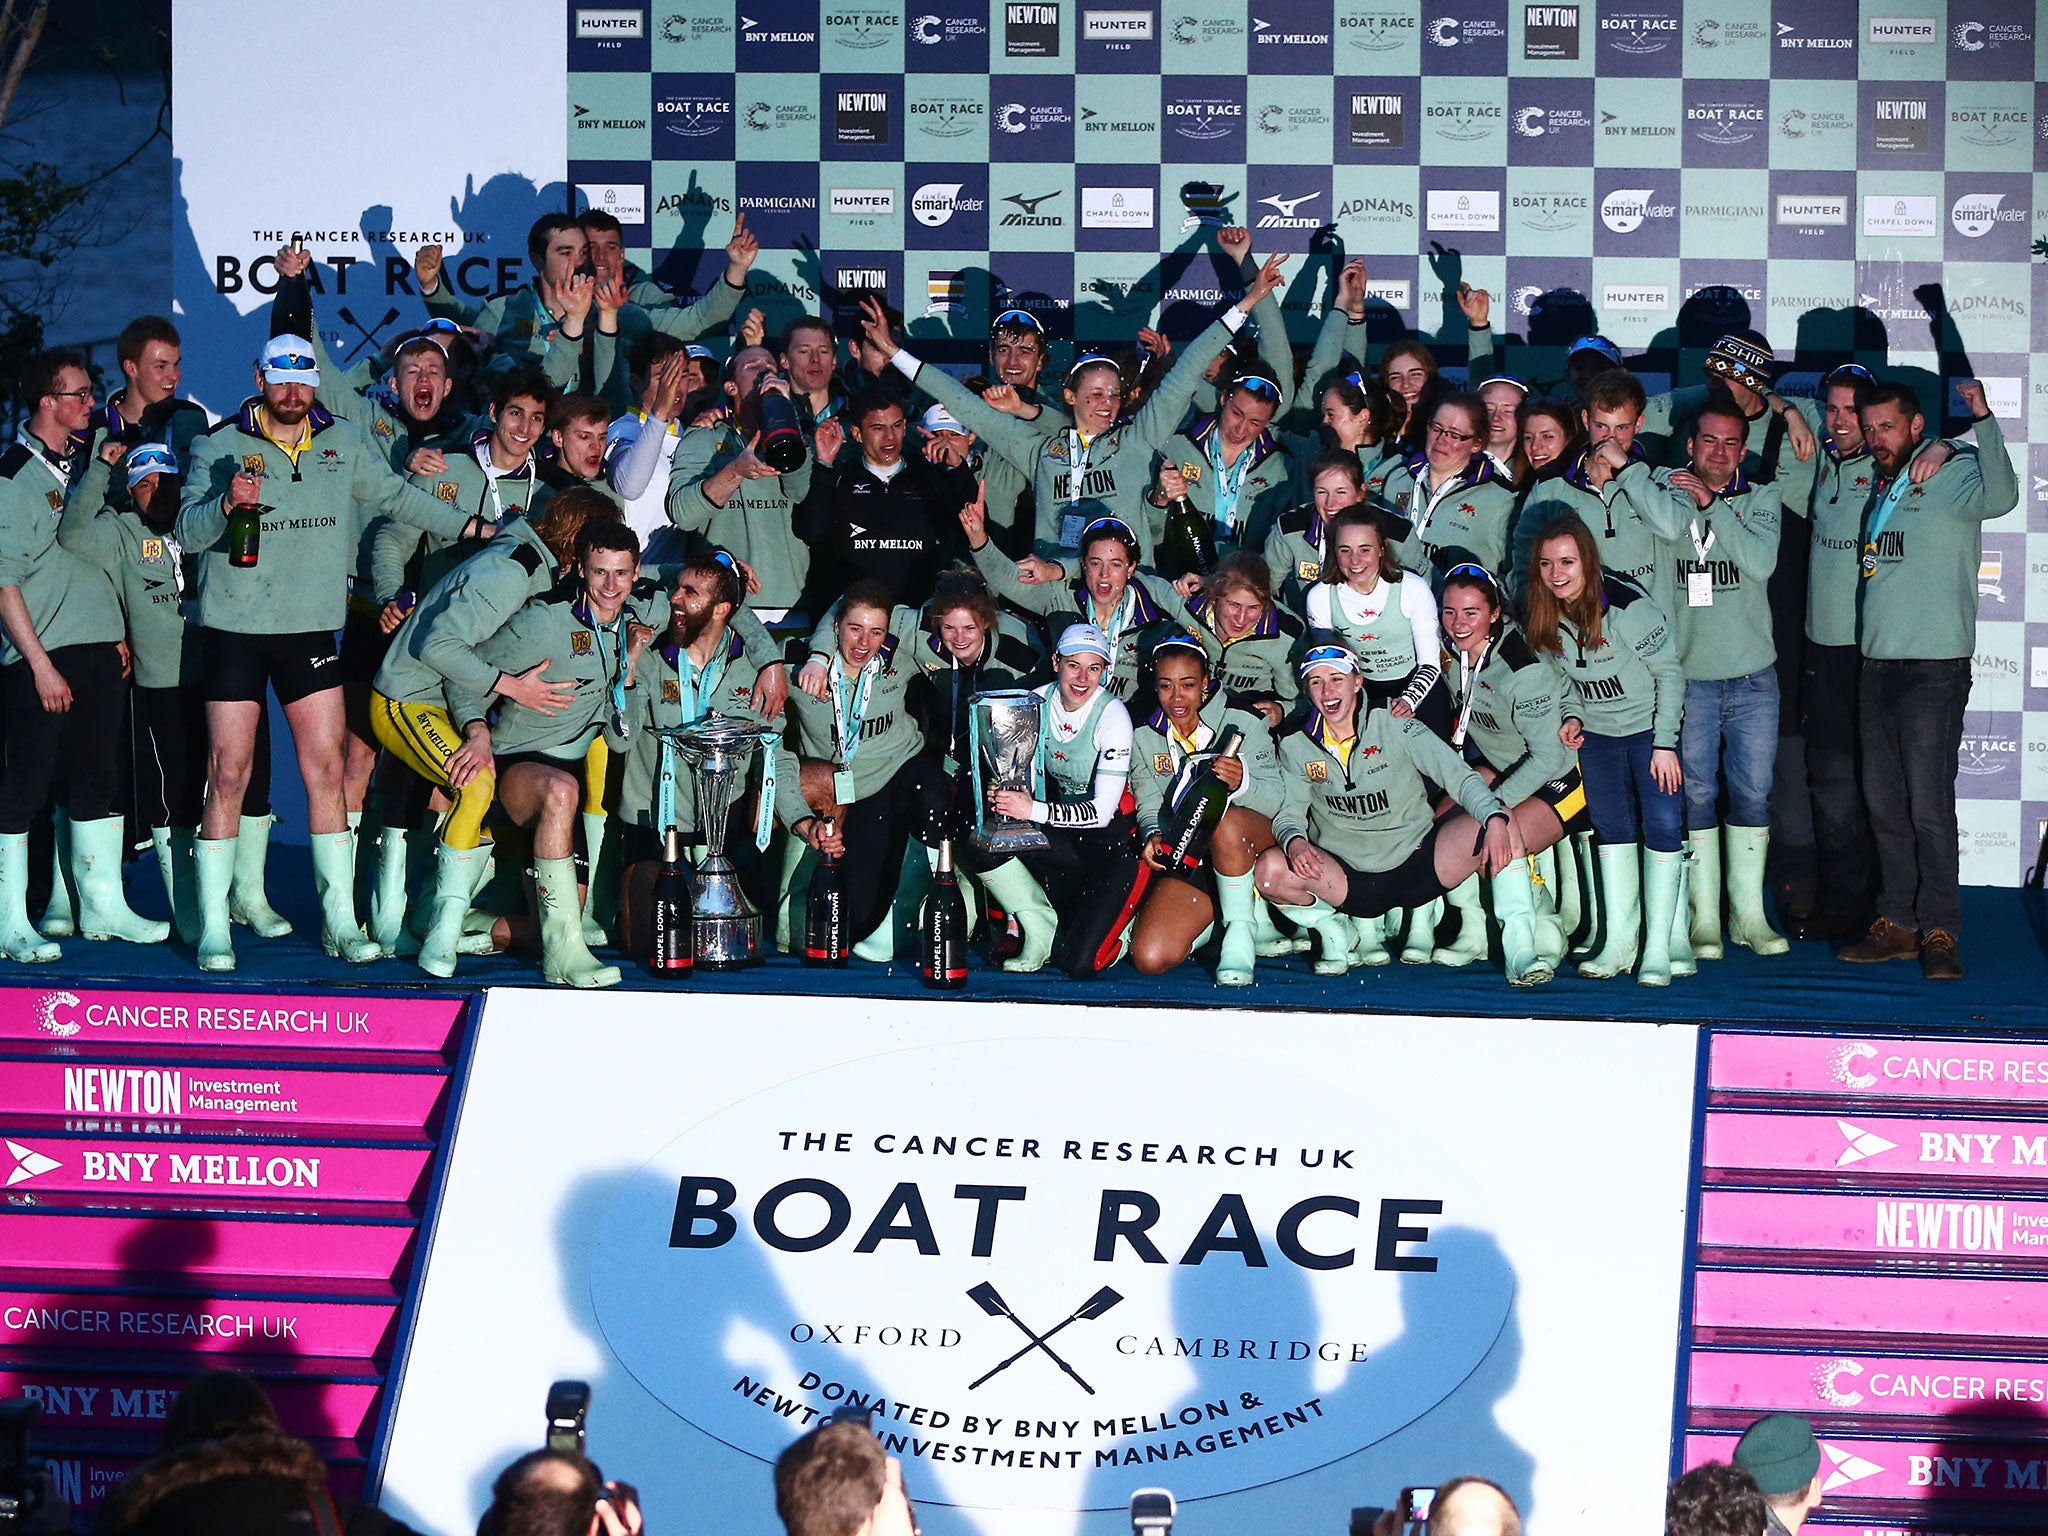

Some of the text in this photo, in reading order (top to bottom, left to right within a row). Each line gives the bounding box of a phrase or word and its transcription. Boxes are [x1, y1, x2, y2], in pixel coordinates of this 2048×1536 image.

[826, 16, 898, 25] BOAT RACE
[1009, 6, 1056, 24] NEWTON
[1528, 8, 1576, 27] NEWTON
[582, 20, 636, 28] HUNTER
[1090, 21, 1146, 29] HUNTER
[1341, 18, 1414, 27] BOAT RACE
[1602, 20, 1677, 30] BOAT RACE
[1874, 26, 1931, 34] HUNTER
[746, 33, 814, 41] BNY MELLON
[1258, 35, 1328, 44] BNY MELLON
[1989, 32, 2030, 40] RESEARCH
[1781, 39, 1852, 48] BNY MELLON
[1006, 47, 1045, 56] Management
[658, 103, 729, 112] BOAT RACE
[839, 94, 885, 111] NEWTON
[1351, 95, 1401, 115] NEWTON
[776, 105, 809, 114] CANCER
[911, 104, 983, 113] BOAT RACE
[1167, 104, 1241, 115] BOAT RACE
[1427, 107, 1500, 117] BOAT RACE
[1877, 101, 1926, 119] NEWTON
[1030, 114, 1070, 123] RESEARCH
[1549, 110, 1583, 119] CANCER
[1688, 109, 1763, 121] BOAT RACE
[1952, 112, 2027, 122] BOAT RACE
[578, 120, 645, 128] BNY MELLON
[1085, 123, 1155, 131] BNY MELLON
[1548, 118, 1590, 126] RESEARCH
[1605, 127, 1675, 136] BNY MELLON
[1877, 142, 1914, 151] Management
[740, 198, 815, 208] PARMIGIANI
[834, 197, 889, 205] HUNTER
[914, 198, 984, 212] smartwater
[1513, 198, 1586, 207] BOAT RACE
[1604, 203, 1676, 219] smartwater
[1686, 206, 1763, 216] PARMIGIANI
[1784, 206, 1840, 214] HUNTER
[1954, 208, 2026, 222] smartwater
[253, 231, 283, 241] THE
[369, 232, 454, 243] RESEARCH
[463, 232, 485, 243] UK
[839, 270, 885, 288] NEWTON
[1607, 294, 1664, 302] HUNTER
[1727, 289, 1760, 300] RACE
[1772, 297, 1851, 308] PARMIGIANI
[1891, 310, 1936, 319] MELLON
[1724, 342, 1764, 366] SHIP
[262, 517, 336, 532] BNY MELLON
[854, 540, 922, 550] BNY MELLON
[1408, 664, 1440, 704] NEWTON
[416, 712, 456, 757] BNY MELLO
[1982, 741, 2016, 752] RACE
[1325, 790, 1389, 815] NEWTON
[1172, 796, 1208, 860] CHAPEL DOWN
[85, 1003, 370, 1034] CANCER RESEARCH UK
[1882, 1055, 1994, 1082] CANCER
[64, 1068, 181, 1114] NEWTON
[188, 1077, 280, 1094] Investment
[188, 1094, 299, 1115] Management
[779, 1132, 1356, 1169] THE CANCER RESEARCH UK
[1919, 1132, 2002, 1166] BNY
[82, 1150, 321, 1188] BNY MELLON
[668, 1176, 1444, 1272] BOAT RACE
[1876, 1201, 2004, 1250] NEWTON
[4, 1307, 298, 1339] CANCER RESEARCH UK
[790, 1324, 1370, 1364] OXFORD CAMBRIDGE
[1869, 1373, 1985, 1400] CANCER
[22, 1385, 99, 1415] BNY
[798, 1371, 1262, 1439] DONATED BY BNY MELLON &
[1094, 1398, 1325, 1468] MANAGEMENT
[1908, 1456, 1992, 1488] BNY
